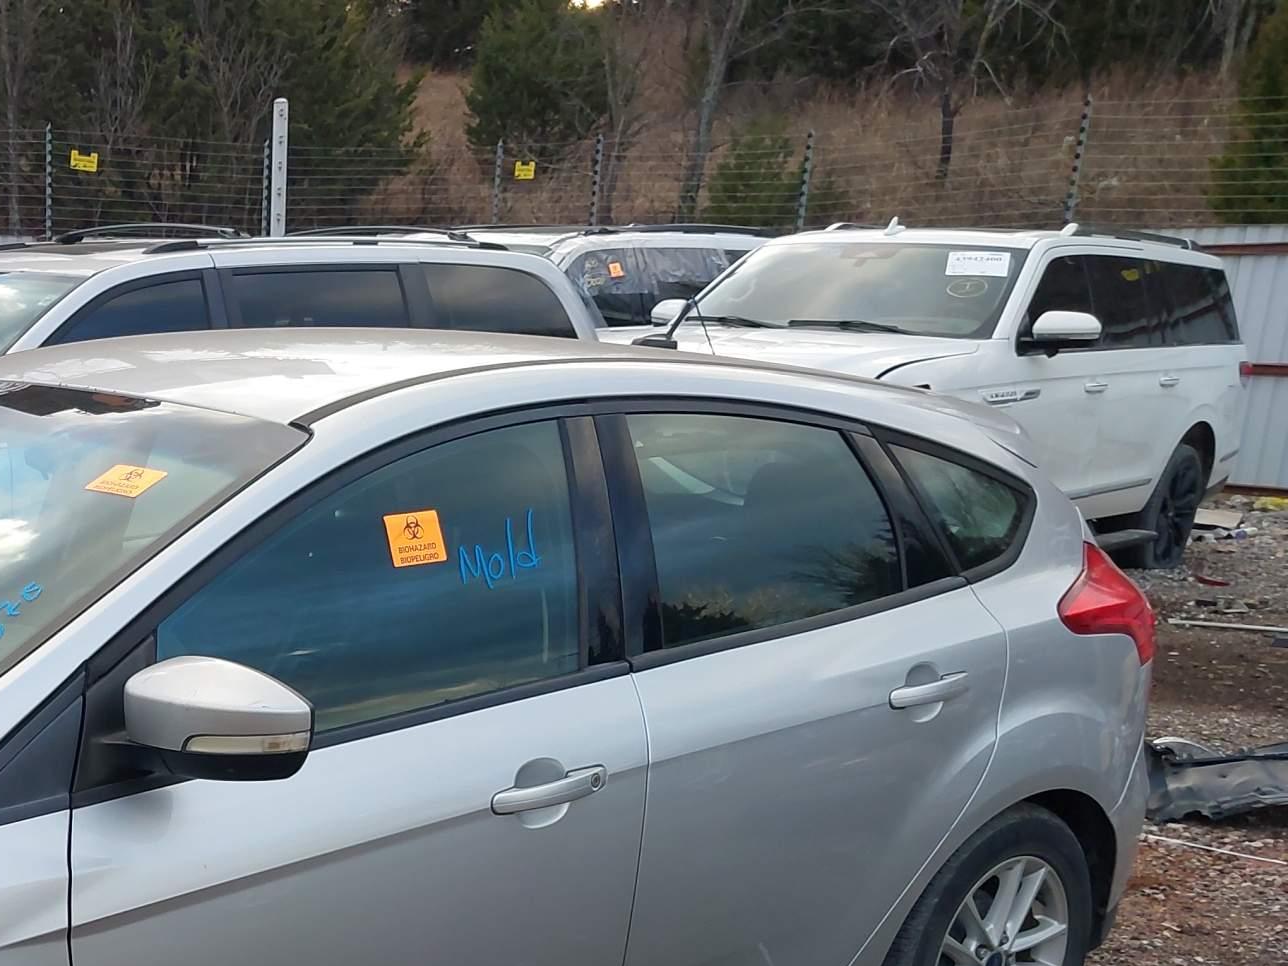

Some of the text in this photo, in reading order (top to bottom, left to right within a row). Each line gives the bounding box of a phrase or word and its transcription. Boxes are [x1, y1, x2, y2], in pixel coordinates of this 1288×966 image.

[398, 542, 437, 554] BIOHAZARD
[458, 508, 541, 589] Mold
[400, 552, 440, 565] BIOPELIGRO
